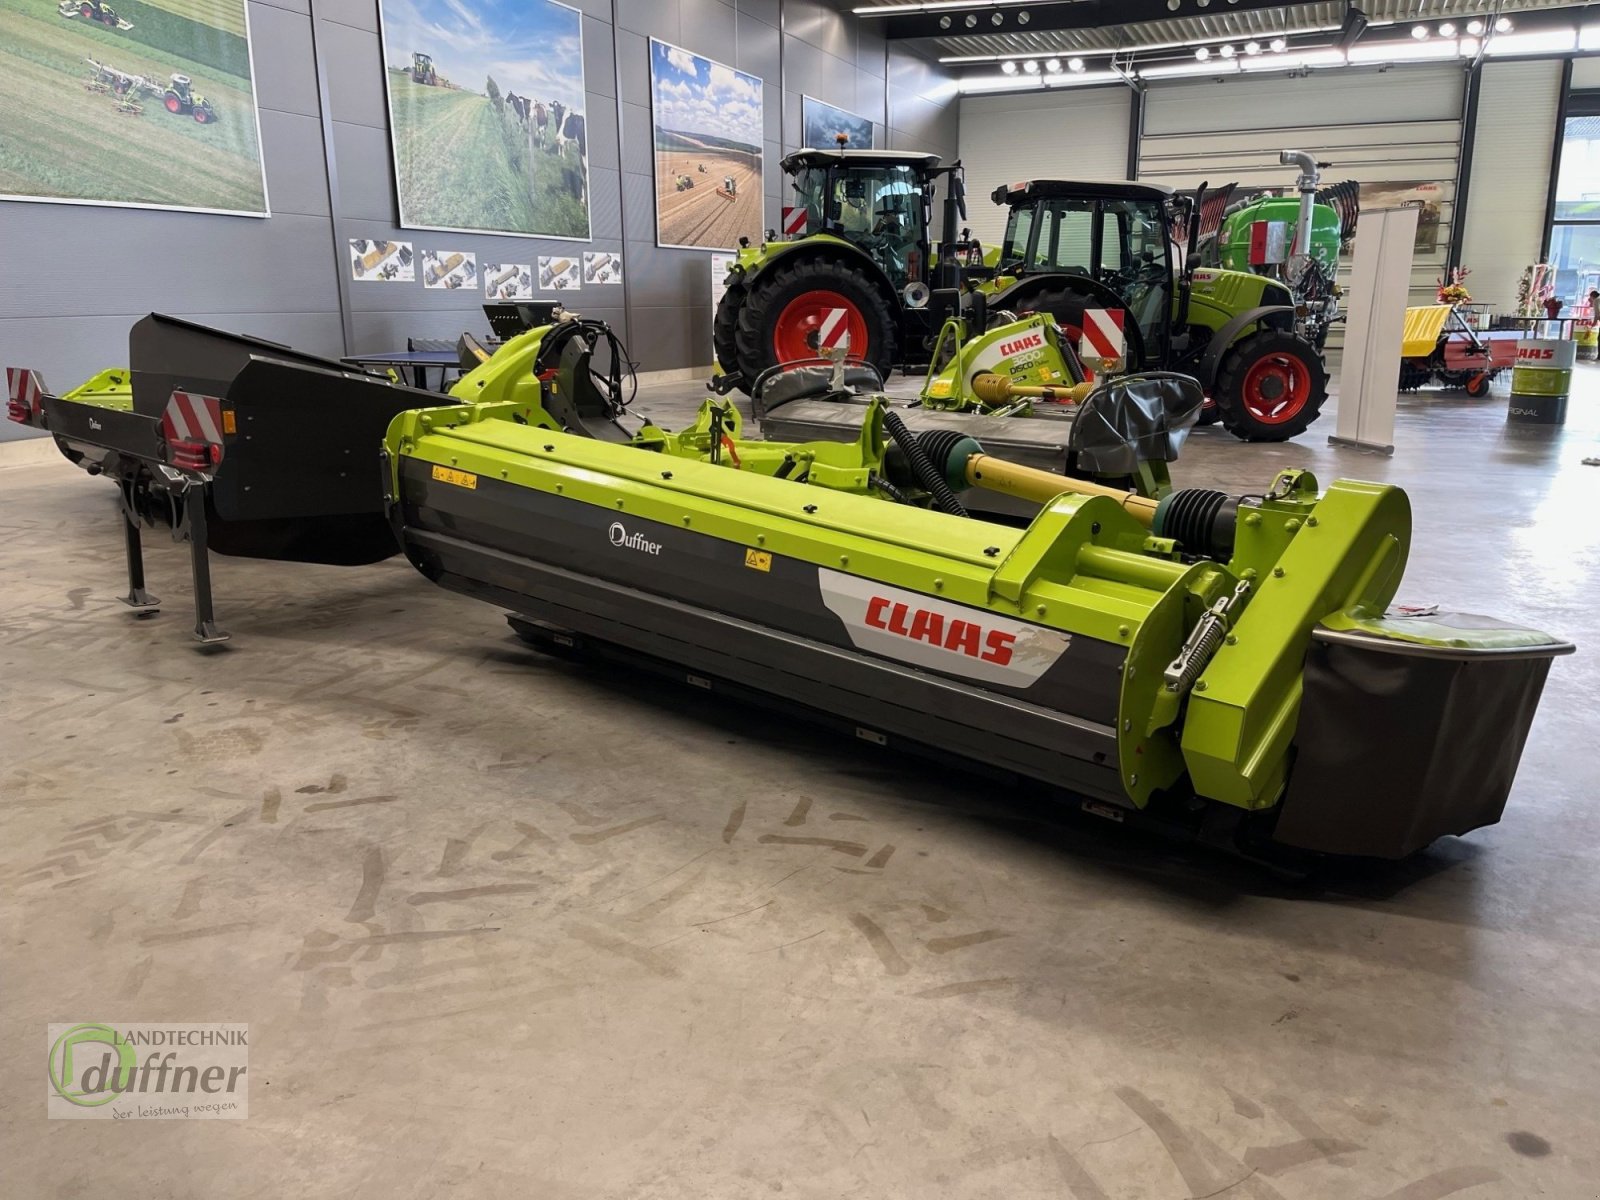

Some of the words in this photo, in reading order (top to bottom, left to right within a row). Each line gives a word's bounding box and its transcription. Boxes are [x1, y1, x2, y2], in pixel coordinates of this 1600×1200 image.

[1000, 334, 1042, 357] CLAAS
[1516, 348, 1554, 359] AAS
[1011, 350, 1041, 366] 3200
[1009, 361, 1034, 375] DISCO
[608, 521, 663, 556] Duffner
[865, 596, 1017, 667] CLAAS
